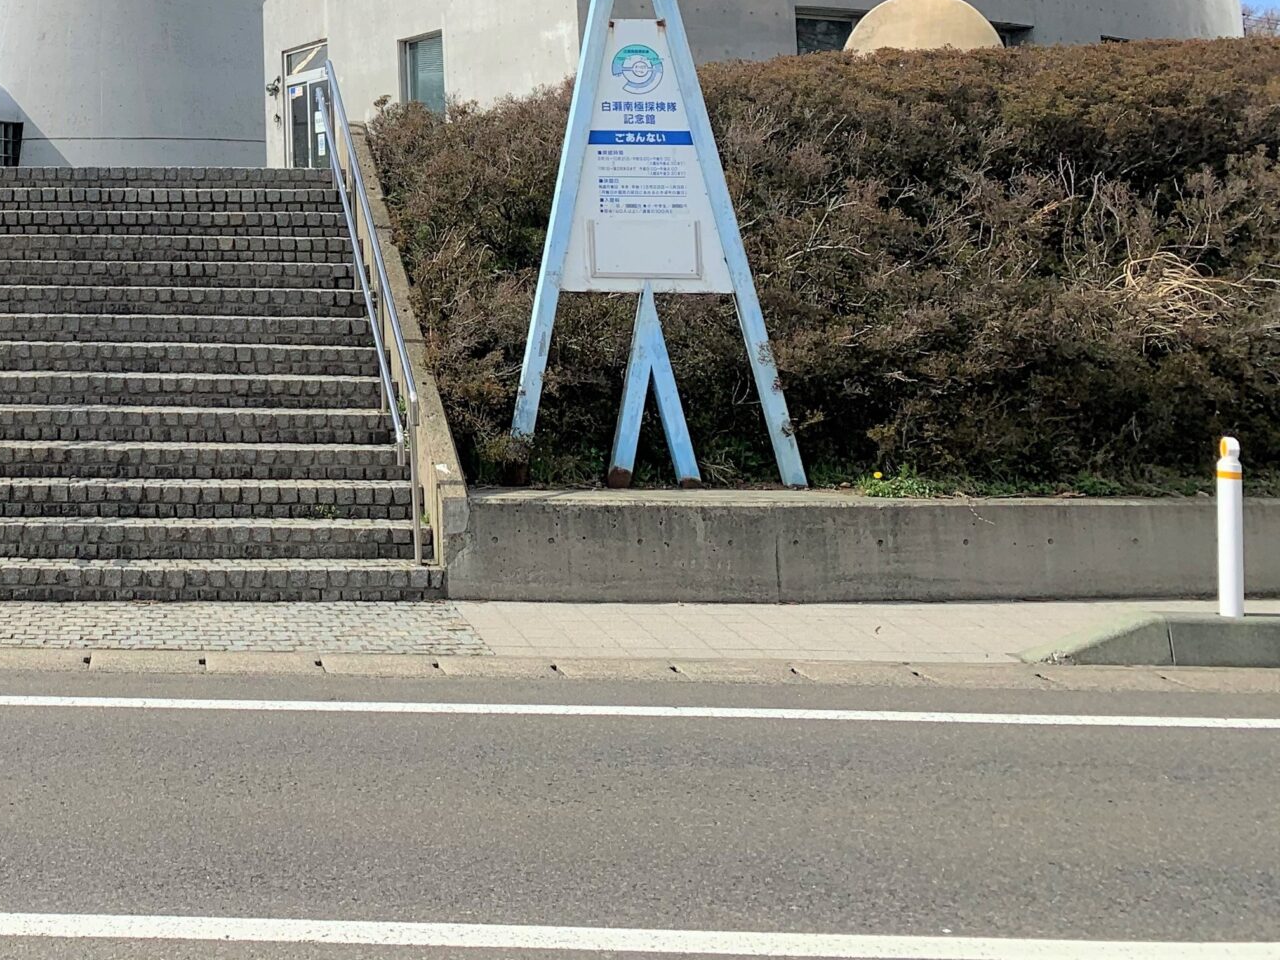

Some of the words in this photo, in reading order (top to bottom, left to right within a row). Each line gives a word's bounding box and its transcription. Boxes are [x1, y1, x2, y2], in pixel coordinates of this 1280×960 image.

[601, 101, 677, 112] 白瀬南極探検隊
[624, 114, 656, 124] 記念館
[615, 133, 666, 143] ごあんない
